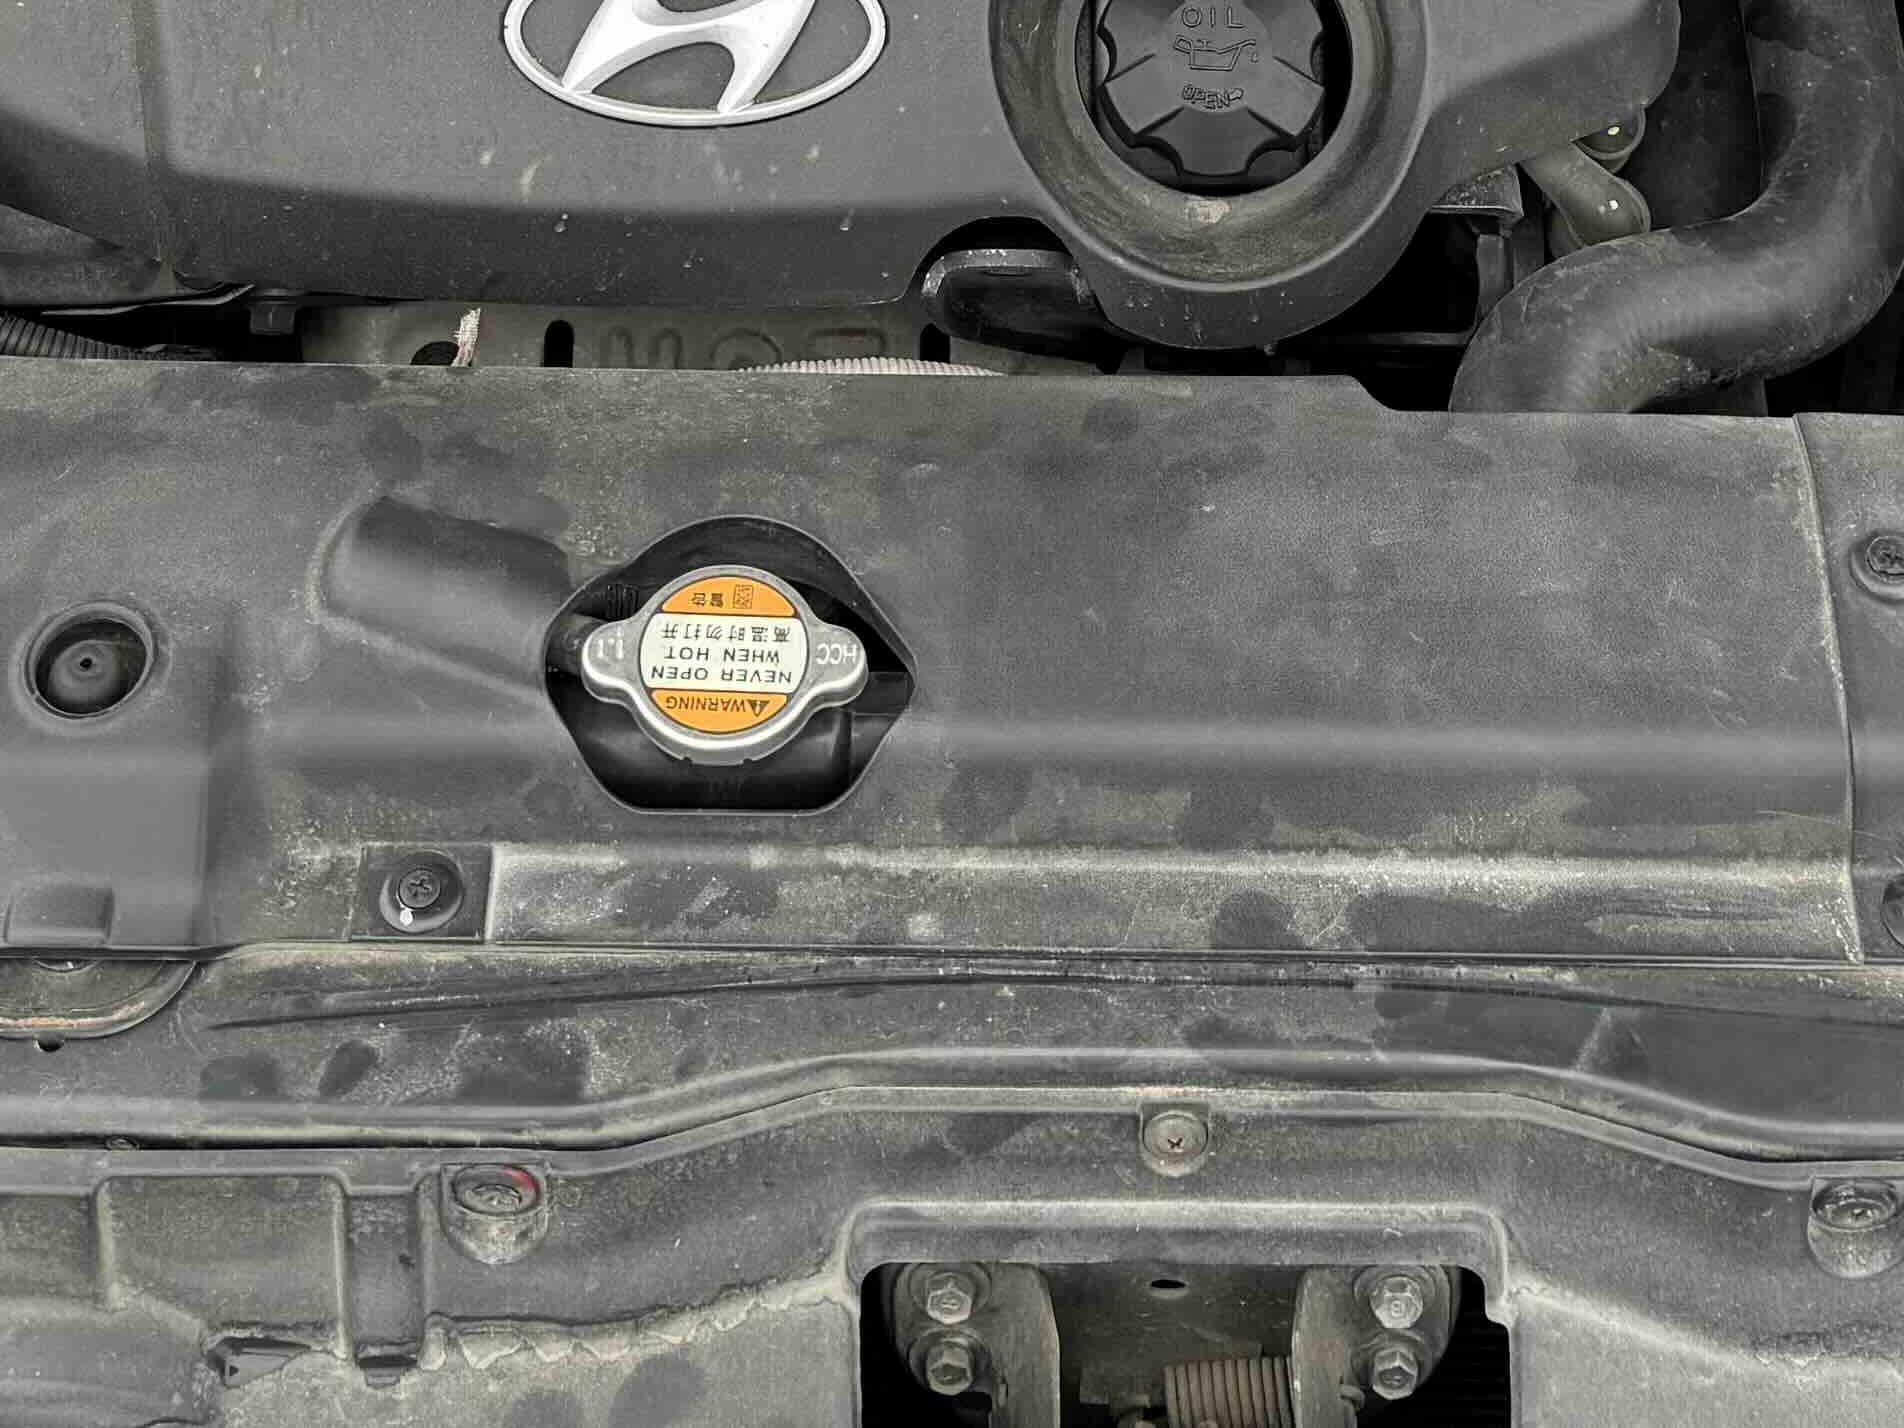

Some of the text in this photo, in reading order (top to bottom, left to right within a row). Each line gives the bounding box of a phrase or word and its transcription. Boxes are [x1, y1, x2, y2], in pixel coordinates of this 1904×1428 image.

[1181, 6, 1248, 30] OIL
[660, 622, 792, 644] 高温时勿打开
[663, 646, 780, 664] WHEN HOT
[815, 642, 858, 666] HCC
[650, 664, 793, 684] NEVER OPEN
[665, 695, 747, 713] WARNING
